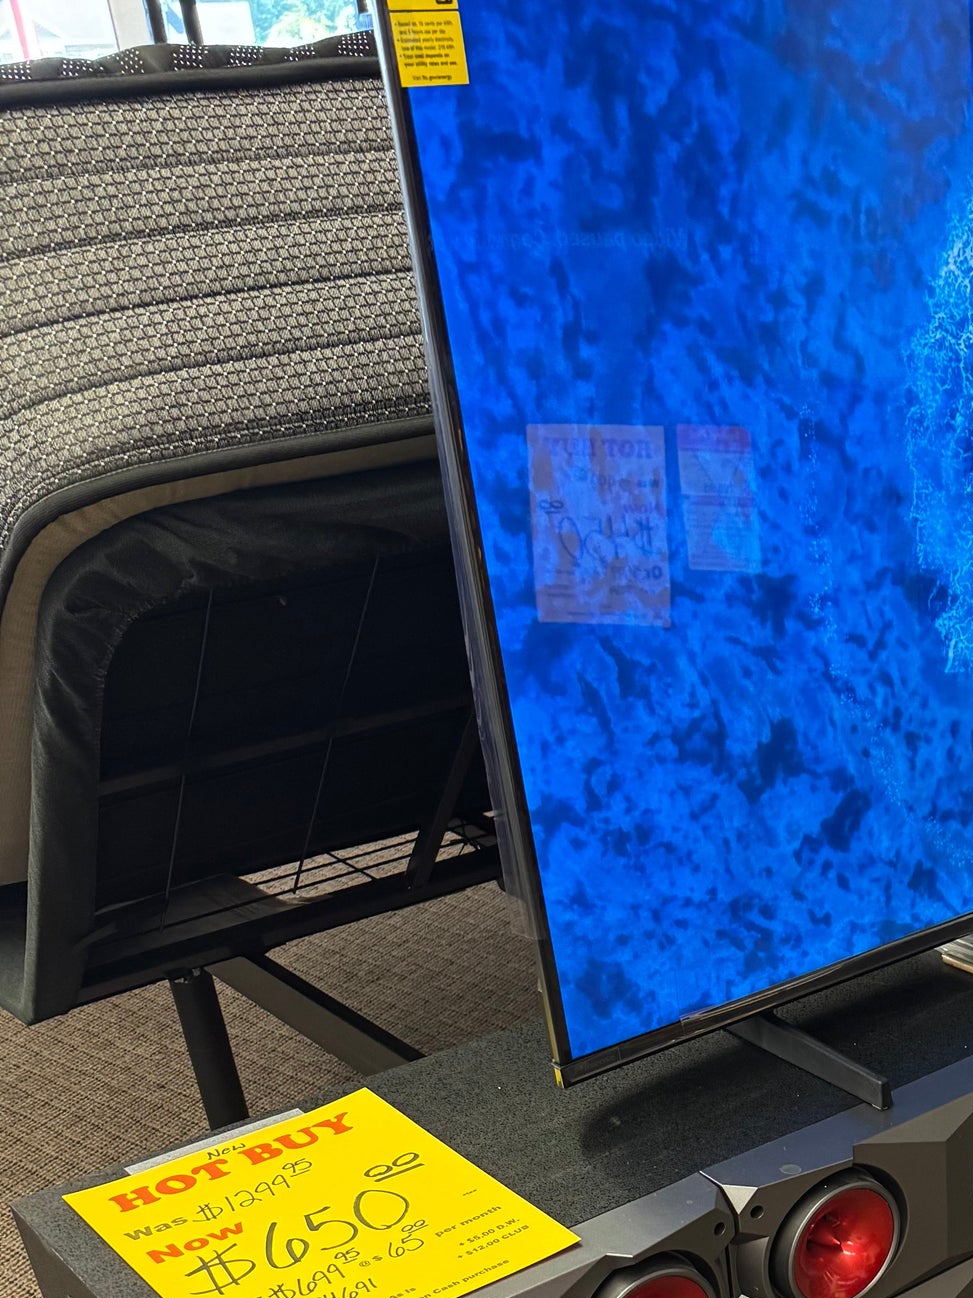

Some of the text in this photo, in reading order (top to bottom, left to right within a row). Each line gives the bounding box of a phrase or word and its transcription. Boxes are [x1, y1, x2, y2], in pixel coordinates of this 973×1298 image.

[109, 1112, 353, 1212] HOT BUY
[207, 1143, 246, 1161] New
[124, 1217, 187, 1241] Was
[434, 1225, 457, 1238] per
[459, 1205, 502, 1225] month
[467, 1228, 495, 1246] $5.00
[146, 1222, 243, 1264] Now
[185, 1189, 409, 1296] $650
[465, 1238, 500, 1257] $12.00
[501, 1224, 529, 1240] CLUB
[405, 1286, 417, 1295] Is
[433, 1281, 460, 1295] Cash
[462, 1259, 510, 1283] purchase
